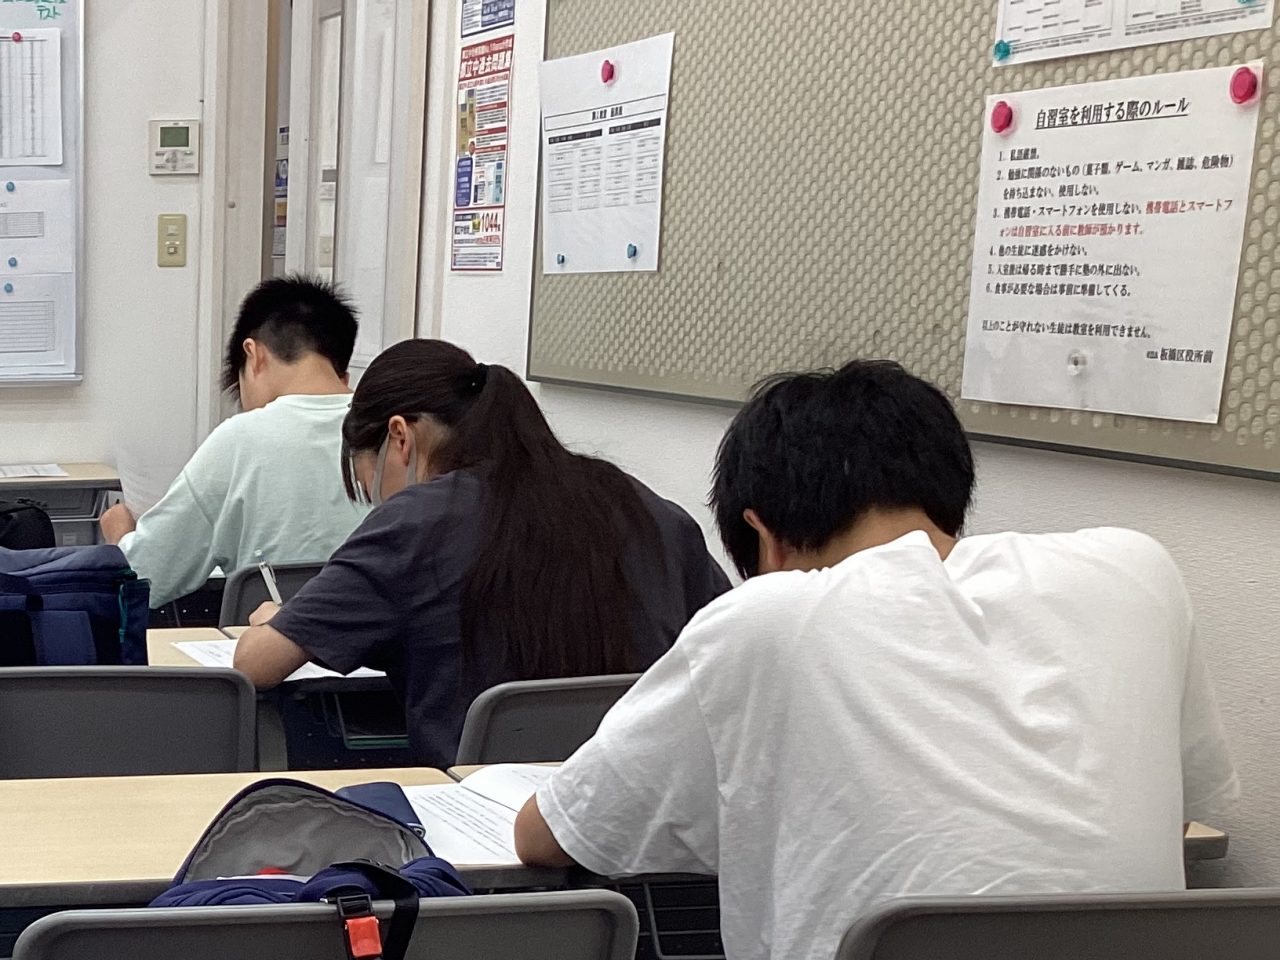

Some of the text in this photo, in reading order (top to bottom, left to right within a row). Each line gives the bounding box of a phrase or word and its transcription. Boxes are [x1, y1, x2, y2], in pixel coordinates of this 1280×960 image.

[1035, 97, 1191, 130] 自習室を利用する際のルール
